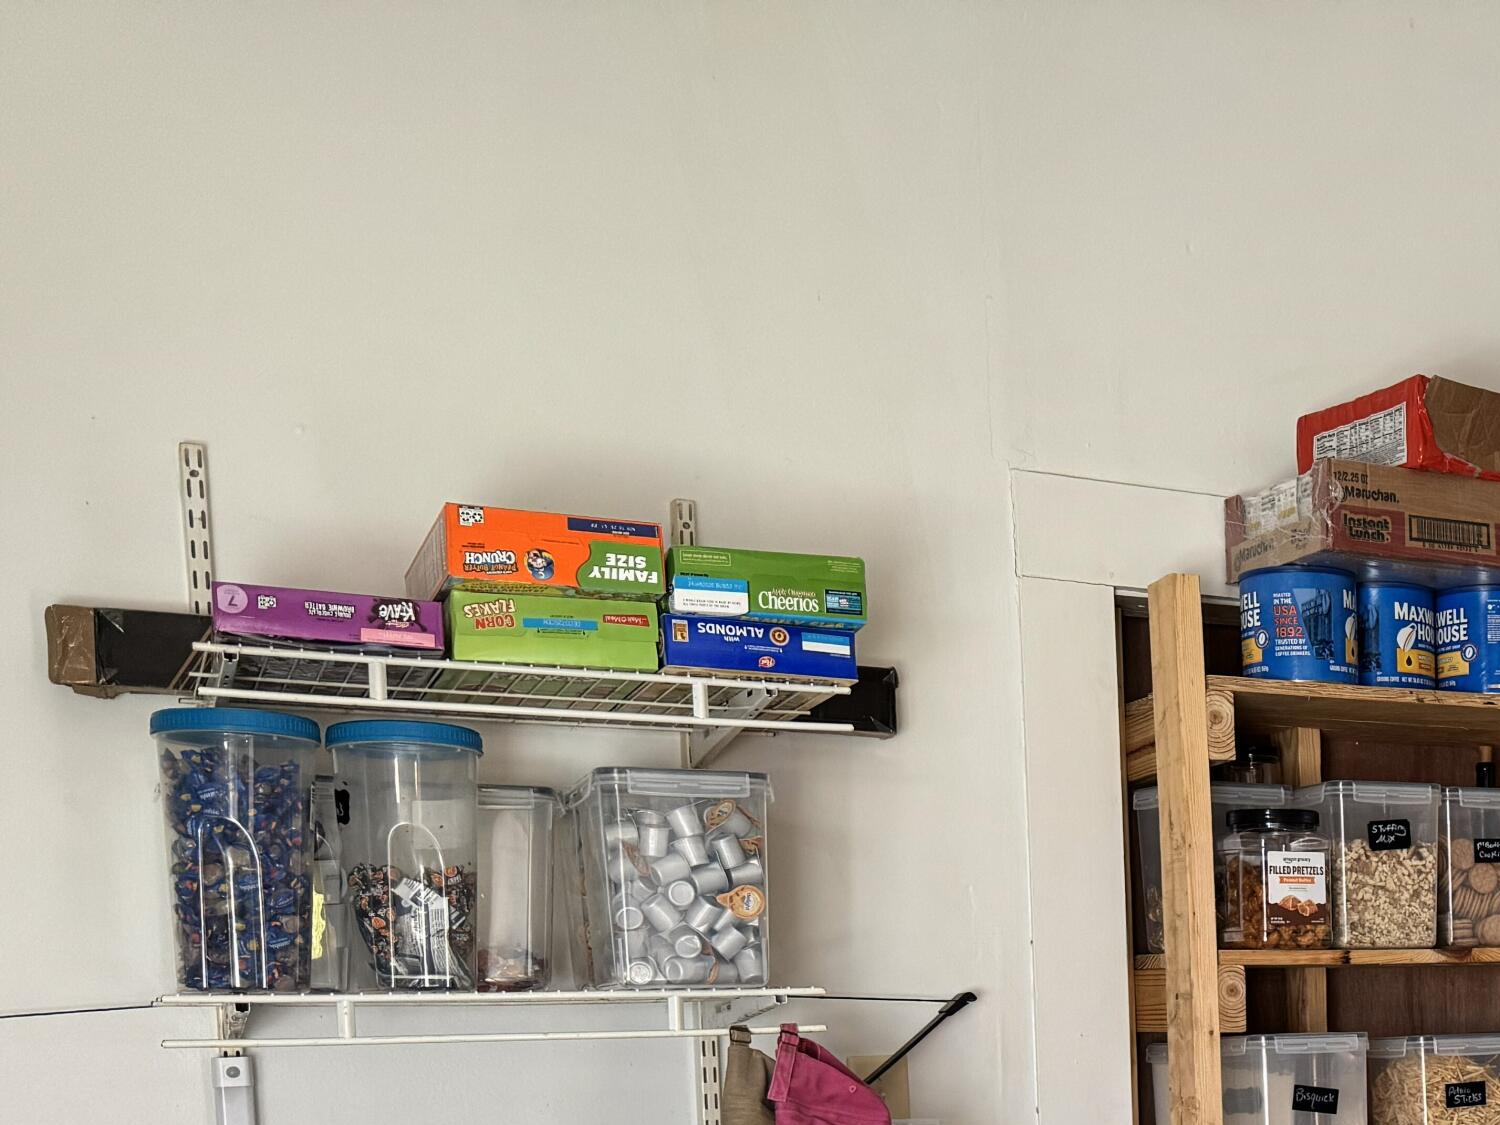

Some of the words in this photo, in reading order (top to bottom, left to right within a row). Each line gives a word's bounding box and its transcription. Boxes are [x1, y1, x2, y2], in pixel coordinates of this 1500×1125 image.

[1343, 513, 1390, 529] Instant
[464, 551, 516, 564] CRUNCH
[605, 553, 646, 567] SIZE
[589, 565, 658, 583] FAMILY
[464, 599, 516, 617] FLAKES
[758, 590, 819, 613] Cheerios
[1273, 605, 1297, 615] USA
[475, 615, 515, 629] CORN
[1274, 616, 1298, 625] SINCE
[697, 622, 764, 637] ALMONDS
[1276, 626, 1303, 638] 1892
[724, 635, 741, 643] with
[1269, 865, 1291, 875] FILLED
[1292, 866, 1324, 876] PRETZELS
